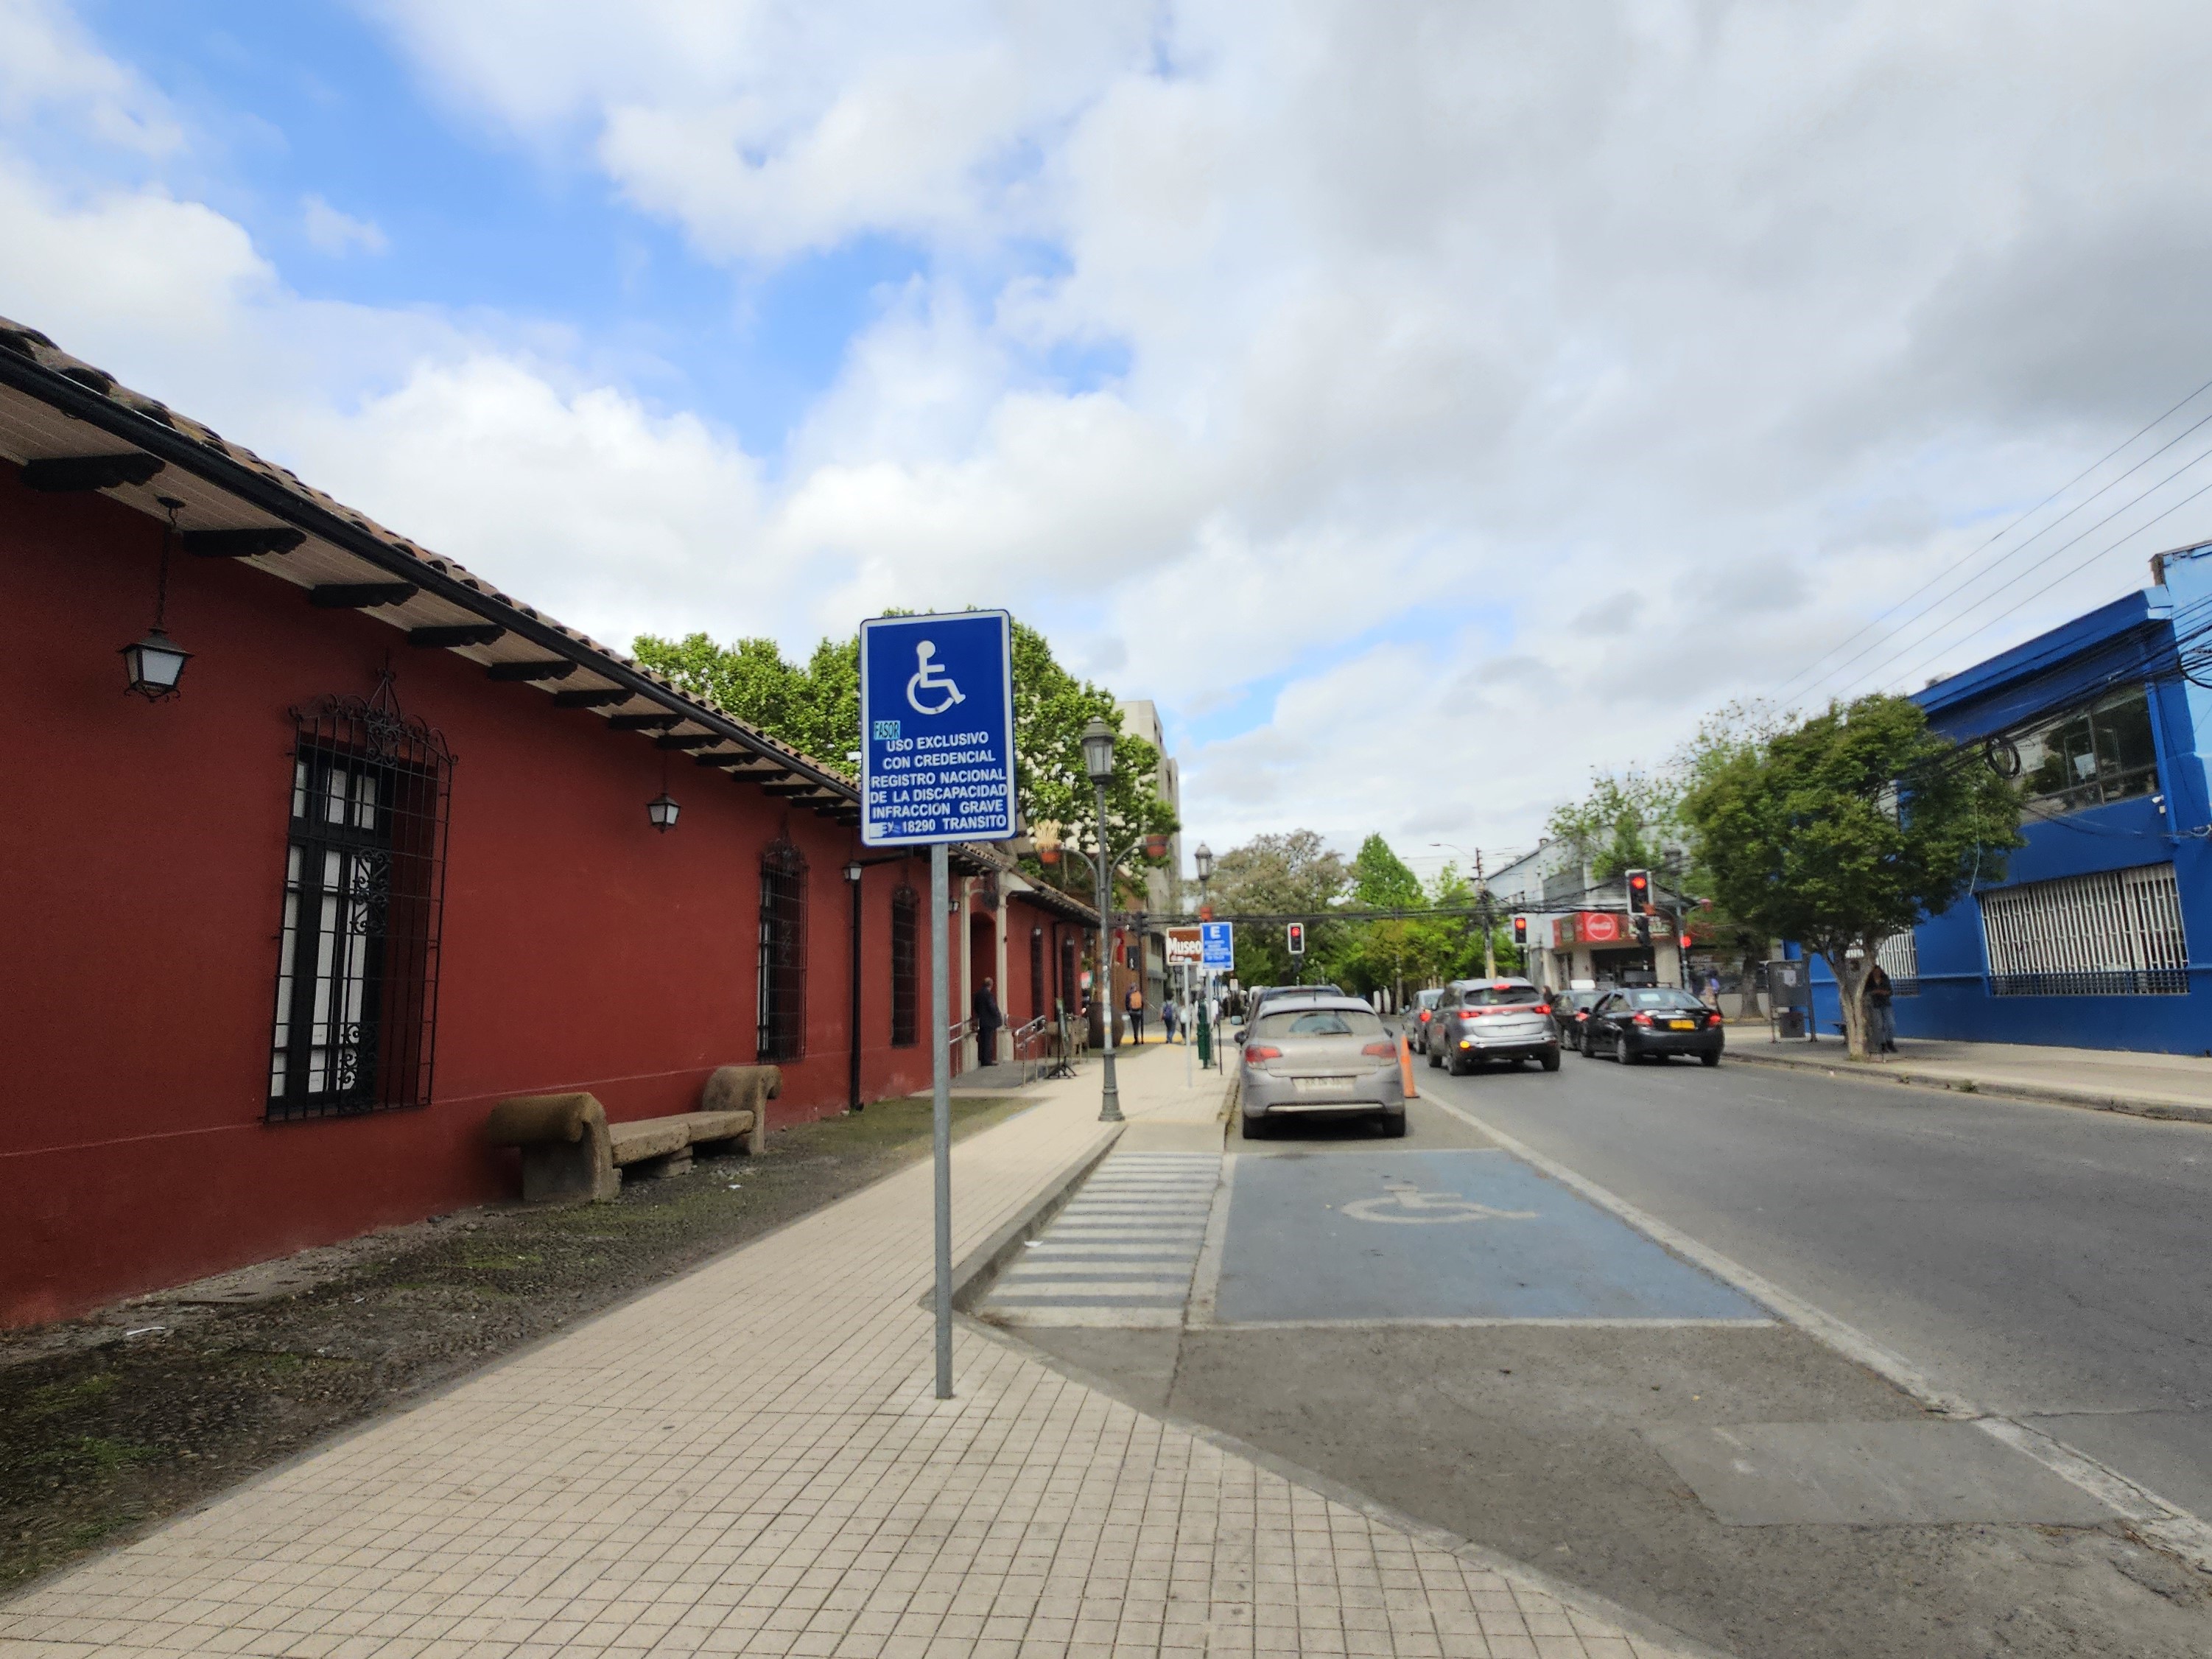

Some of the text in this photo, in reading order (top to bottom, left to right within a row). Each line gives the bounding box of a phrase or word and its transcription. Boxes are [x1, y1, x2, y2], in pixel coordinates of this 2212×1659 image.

[874, 722, 899, 738] FASOR
[886, 732, 989, 752] USO EXCLUSIVO
[883, 749, 996, 771] CON CREDENCIAL
[871, 768, 1006, 788] REGISTRO NACIONAL
[870, 783, 1008, 804] DE LA DISCAPACIDAD
[872, 799, 1004, 819] INFRACCION GRAVE
[874, 814, 1007, 835] EY 18290 TRANSITO
[1210, 926, 1221, 939] E
[1166, 937, 1201, 955] Museo
